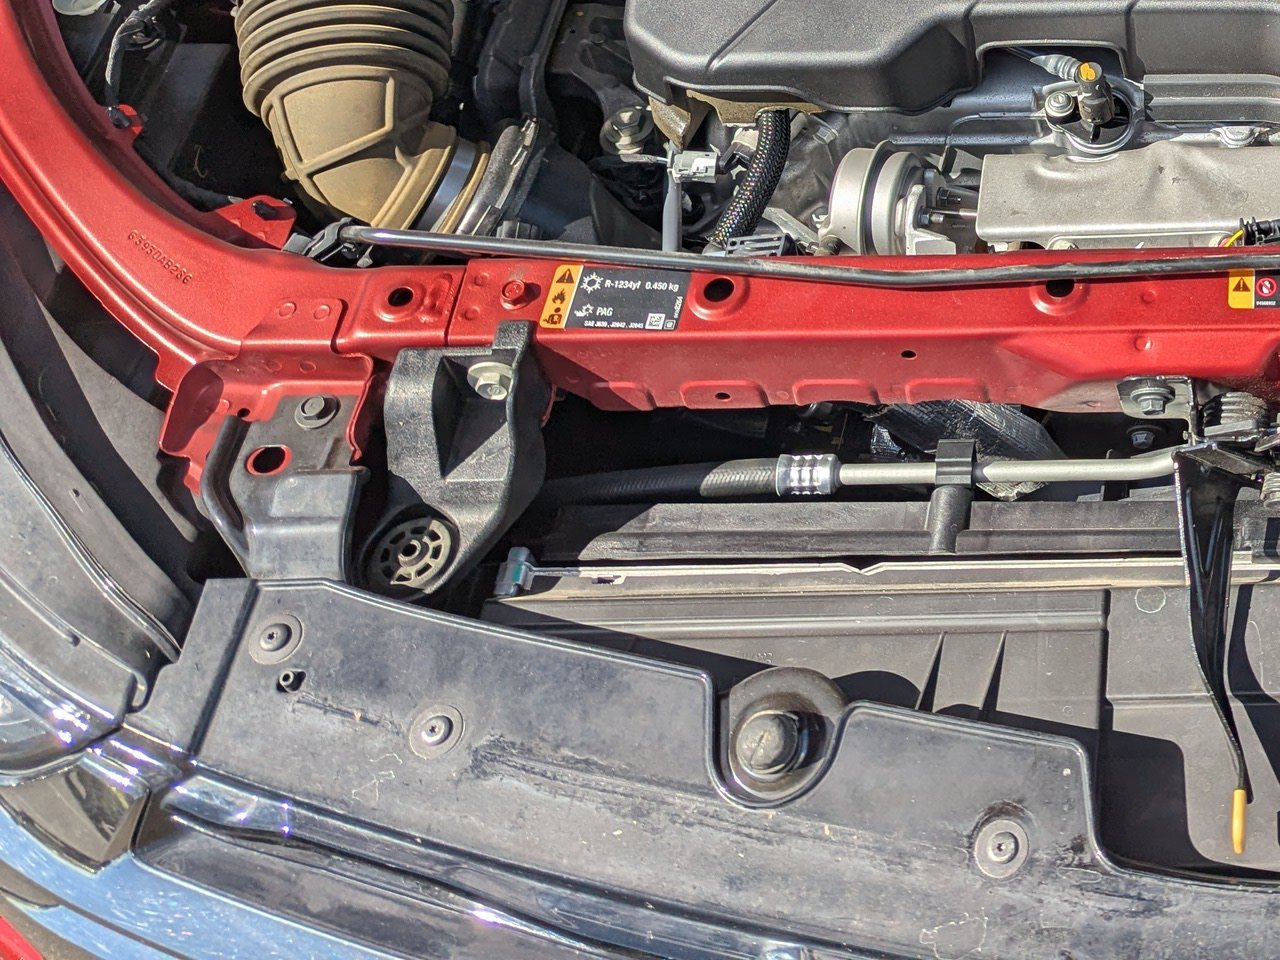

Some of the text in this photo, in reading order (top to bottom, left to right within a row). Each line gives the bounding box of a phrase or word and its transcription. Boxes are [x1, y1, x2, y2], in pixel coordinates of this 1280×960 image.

[604, 279, 679, 293] R-1234yf 0.450 kg
[595, 307, 613, 317] PAG
